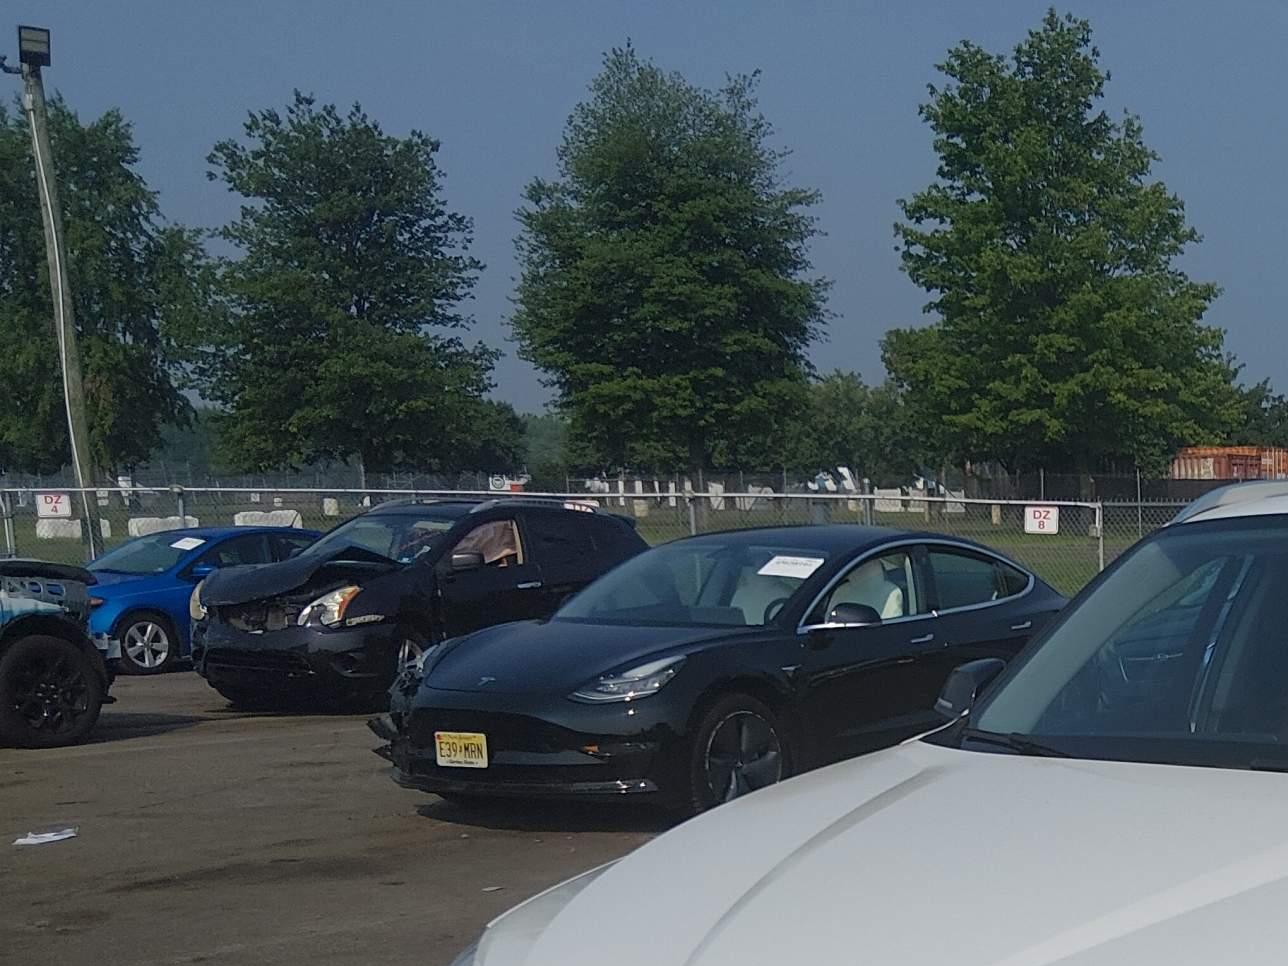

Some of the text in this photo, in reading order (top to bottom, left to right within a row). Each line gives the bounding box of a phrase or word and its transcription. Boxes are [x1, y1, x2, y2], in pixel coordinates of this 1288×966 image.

[44, 495, 63, 505] DZ
[51, 505, 59, 514] 4
[1033, 510, 1051, 520] DZ
[1038, 521, 1046, 530] 8
